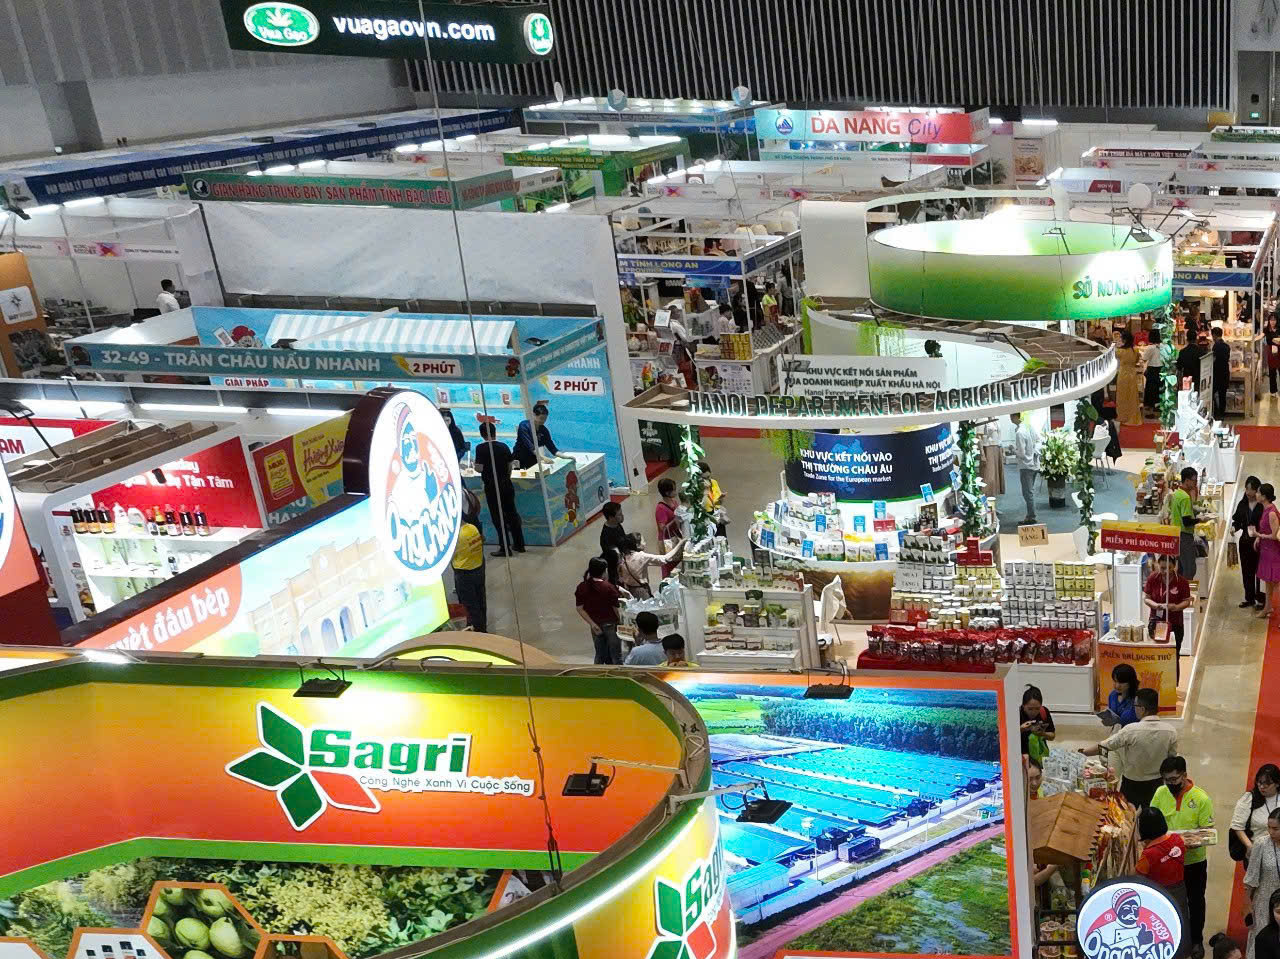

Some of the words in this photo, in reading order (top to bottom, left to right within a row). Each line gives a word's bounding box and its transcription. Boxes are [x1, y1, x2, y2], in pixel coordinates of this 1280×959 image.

[332, 16, 495, 41] vuagaovn.com
[810, 116, 837, 135] DA
[843, 117, 901, 136] NANG
[907, 117, 943, 139] City
[218, 348, 267, 369] CHÂU
[315, 355, 380, 372] NHANH
[413, 363, 421, 372] 2
[422, 359, 456, 374] PHÚT
[554, 380, 561, 390] 2
[564, 376, 598, 392] PHÚT
[815, 450, 835, 463] VỰC
[835, 450, 852, 462] KẾT
[853, 451, 871, 462] NỐI
[872, 451, 893, 462] VÀO
[813, 462, 850, 474] TRƯỜNG
[851, 463, 878, 474] CHÂU
[206, 475, 235, 489] Tâm
[845, 476, 872, 484] European
[153, 607, 194, 644] đầu
[191, 587, 230, 623] bếp
[310, 729, 468, 776] Sagri
[425, 778, 454, 789] Xanh
[471, 779, 500, 793] Cuộc
[504, 779, 531, 794] Sống
[1152, 919, 1170, 941] 1939
